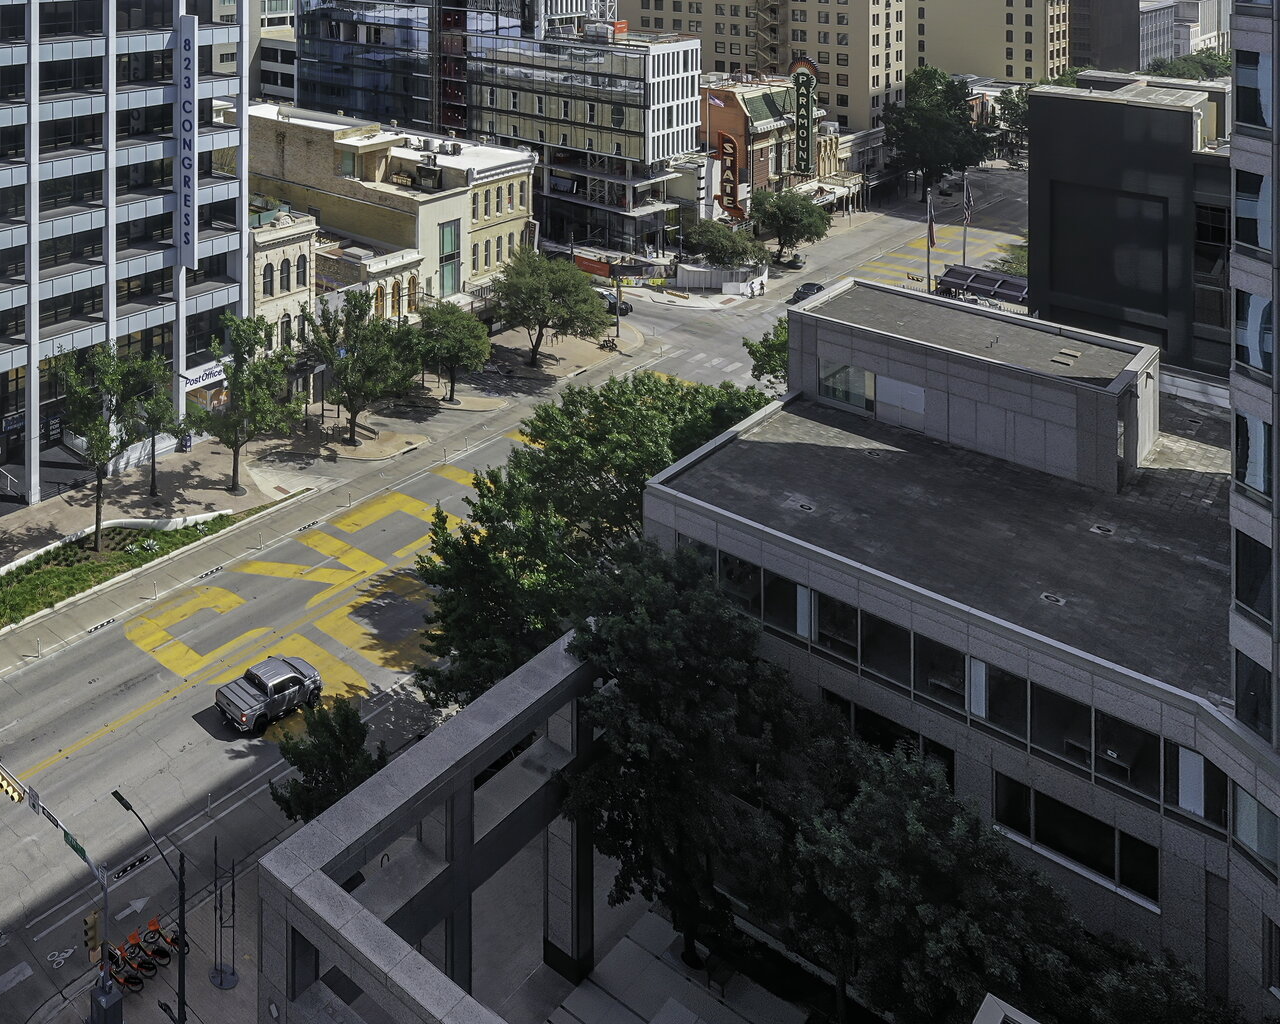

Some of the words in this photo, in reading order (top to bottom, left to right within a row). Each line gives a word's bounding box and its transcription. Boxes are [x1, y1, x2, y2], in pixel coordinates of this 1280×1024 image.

[183, 38, 192, 89] 823
[798, 75, 808, 170] PARAMOUNT
[182, 100, 193, 245] CONGRESS
[722, 143, 734, 208] STATE
[185, 375, 202, 388] Post
[202, 368, 223, 382] Office
